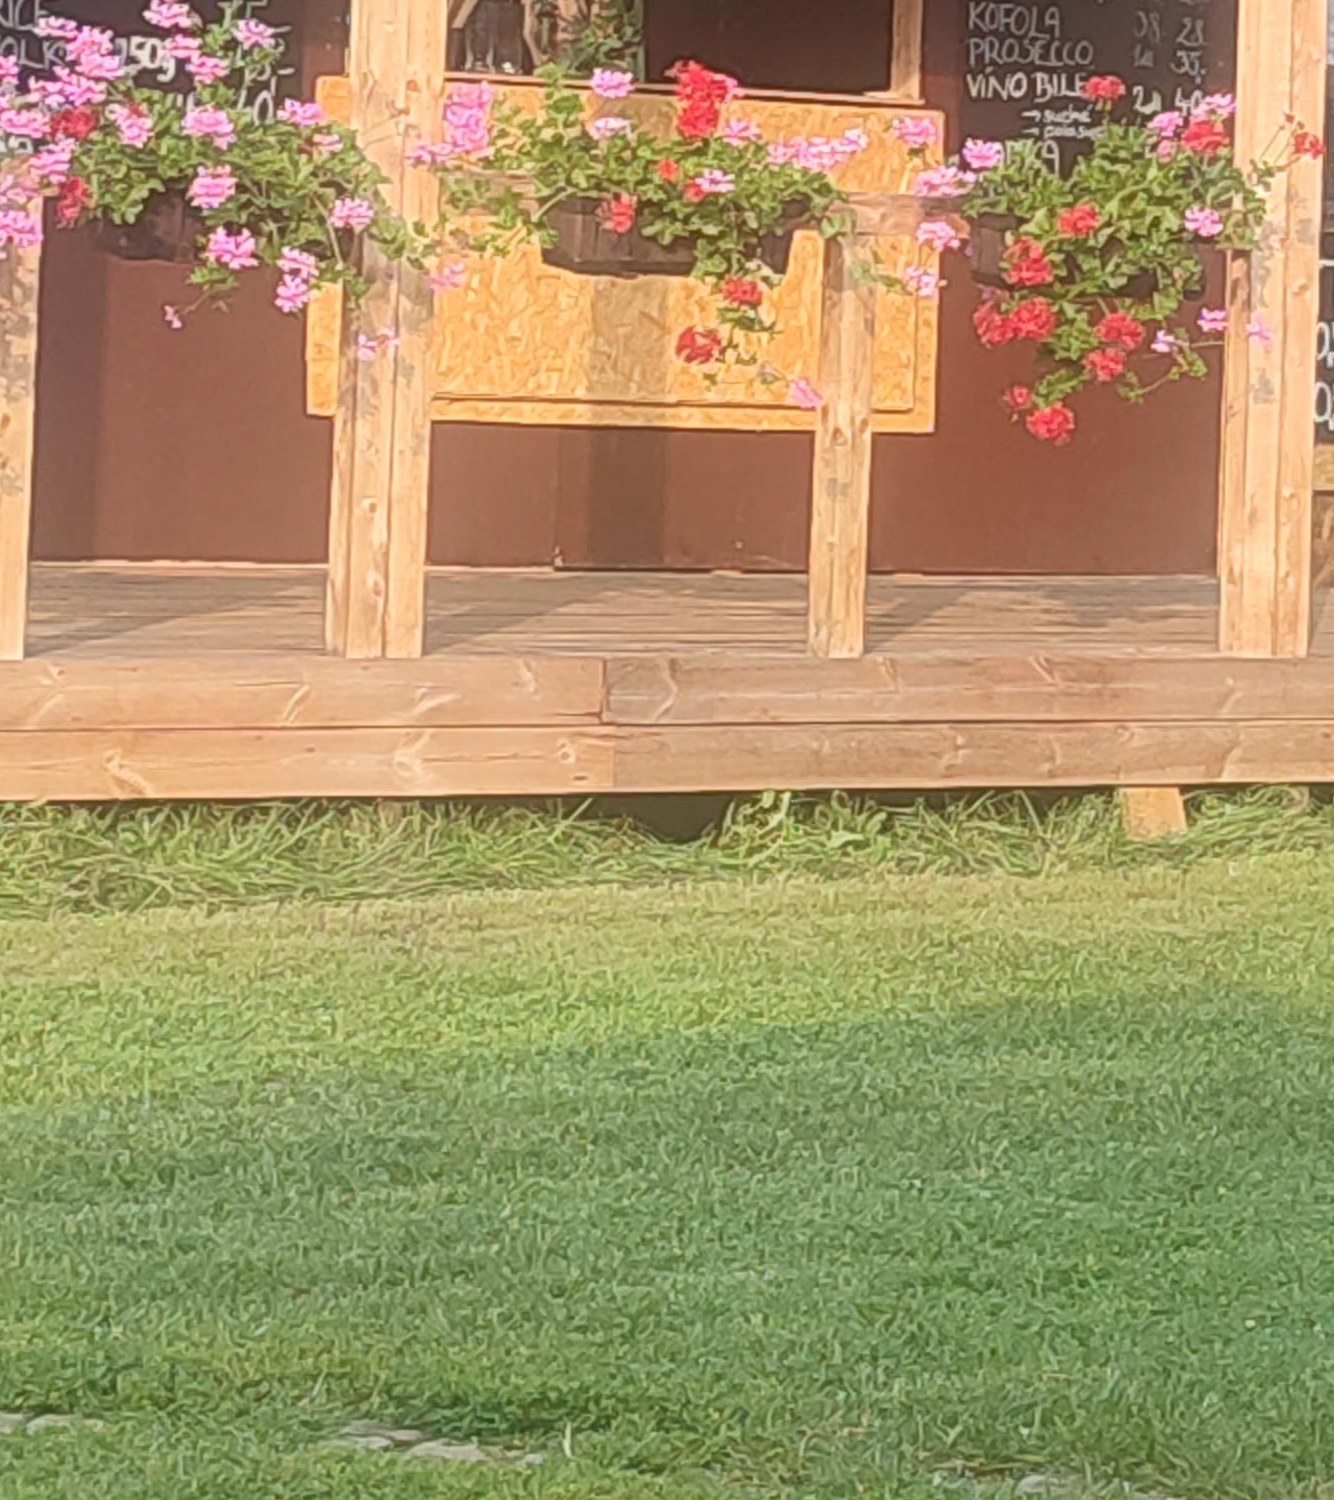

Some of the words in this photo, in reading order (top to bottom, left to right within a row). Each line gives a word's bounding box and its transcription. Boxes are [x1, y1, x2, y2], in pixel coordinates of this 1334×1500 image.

[967, 1, 1060, 41] KOFOLA
[967, 36, 1094, 68] PROSECCO
[966, 66, 1028, 100] VÍNO
